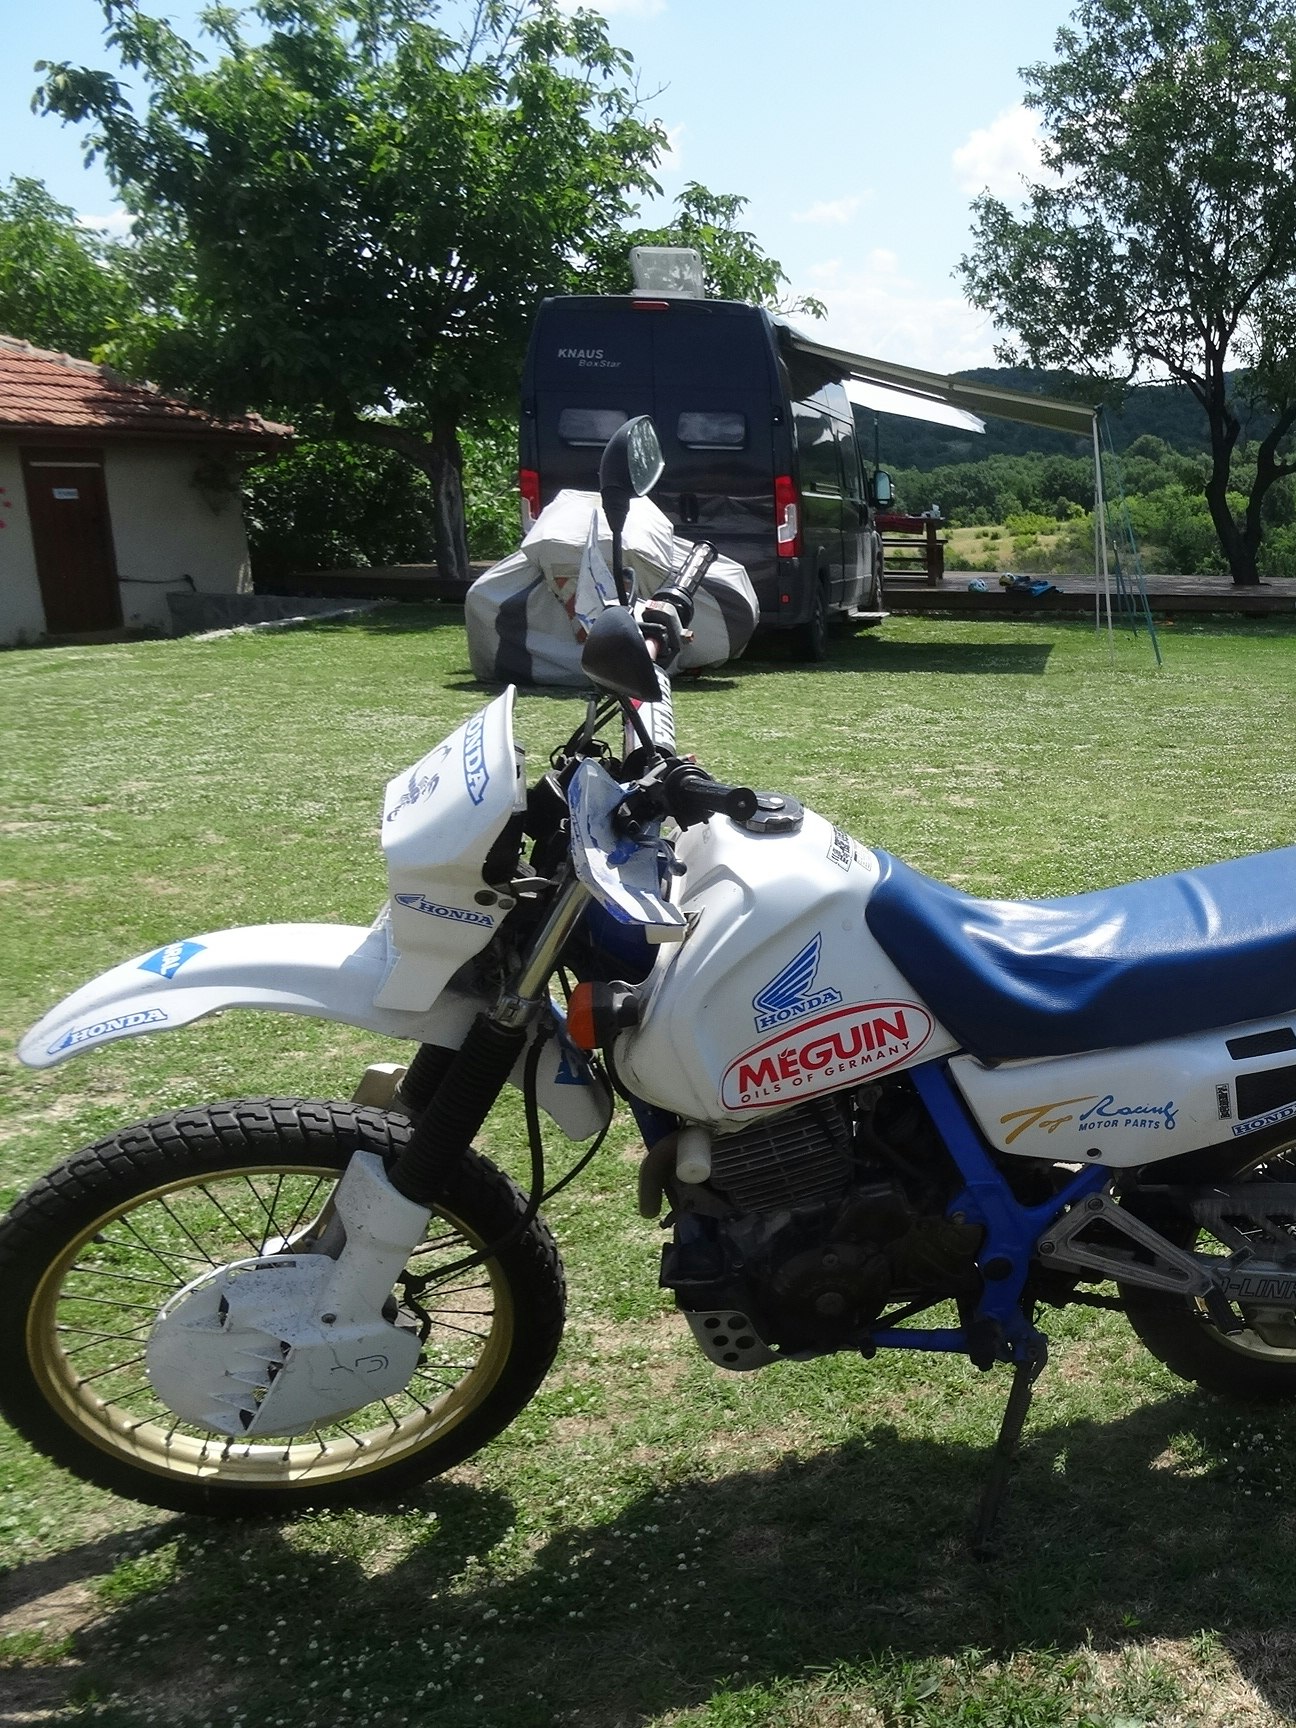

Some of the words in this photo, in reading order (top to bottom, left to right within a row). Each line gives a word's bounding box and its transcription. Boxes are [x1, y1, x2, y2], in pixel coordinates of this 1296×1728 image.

[557, 348, 604, 359] KNAUS
[578, 359, 622, 368] BoxStar
[419, 901, 494, 926] HONDA
[760, 990, 839, 1029] HONDA
[71, 1009, 167, 1044] HONDA
[741, 1083, 782, 1104] OILS
[792, 1072, 814, 1086] OF
[824, 1040, 911, 1077] GERMANY
[1078, 1119, 1119, 1132] MOTOR
[1124, 1119, 1160, 1130] PARTS
[1079, 1095, 1180, 1131] Racing
